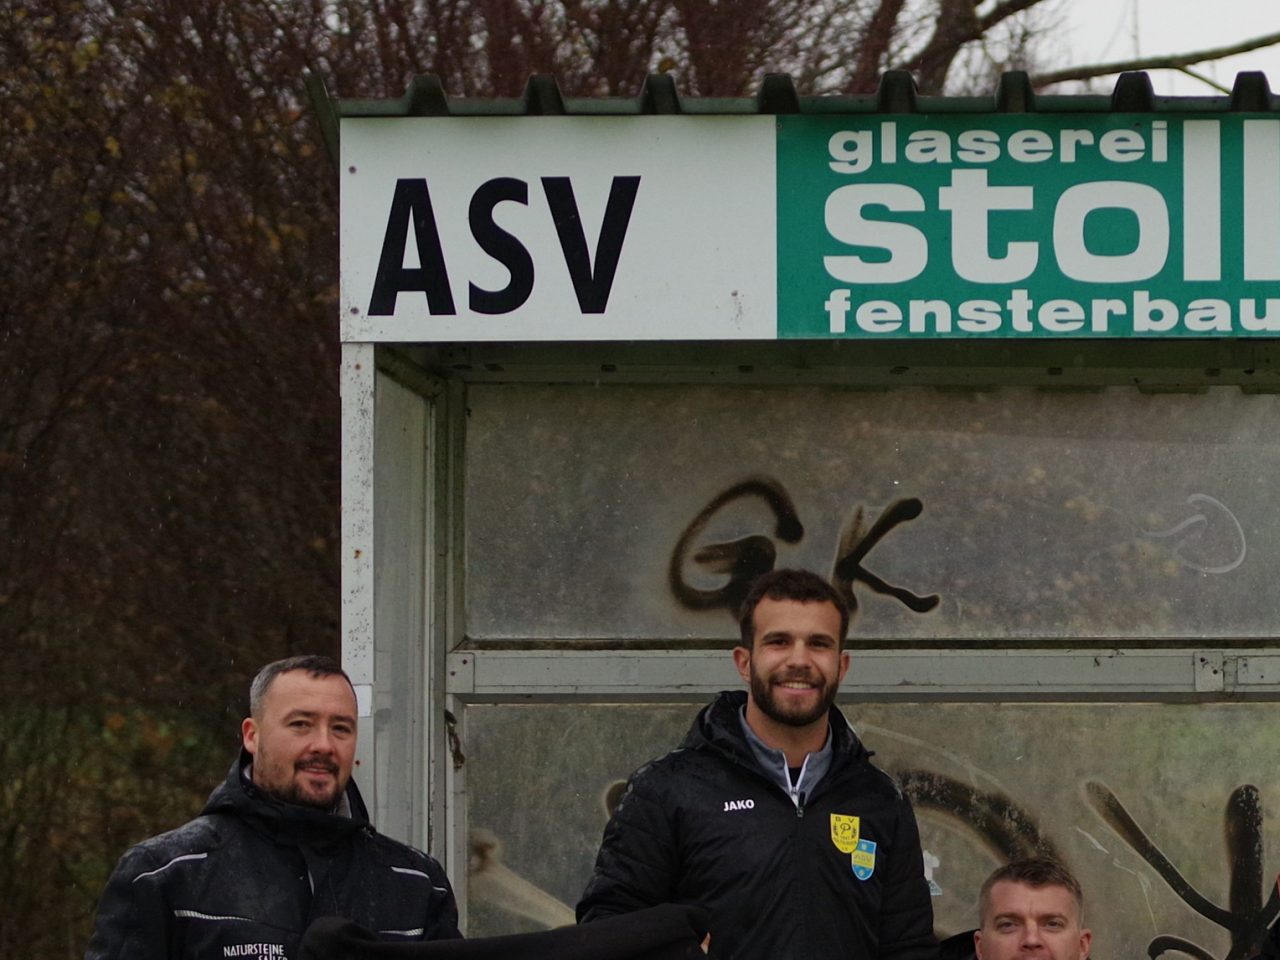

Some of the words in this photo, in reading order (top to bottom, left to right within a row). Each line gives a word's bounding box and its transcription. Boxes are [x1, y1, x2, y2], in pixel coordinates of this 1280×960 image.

[828, 121, 1168, 174] glaserei
[367, 175, 641, 316] ASV
[723, 799, 755, 811] JAKO
[223, 943, 285, 957] NATURSTEINE
